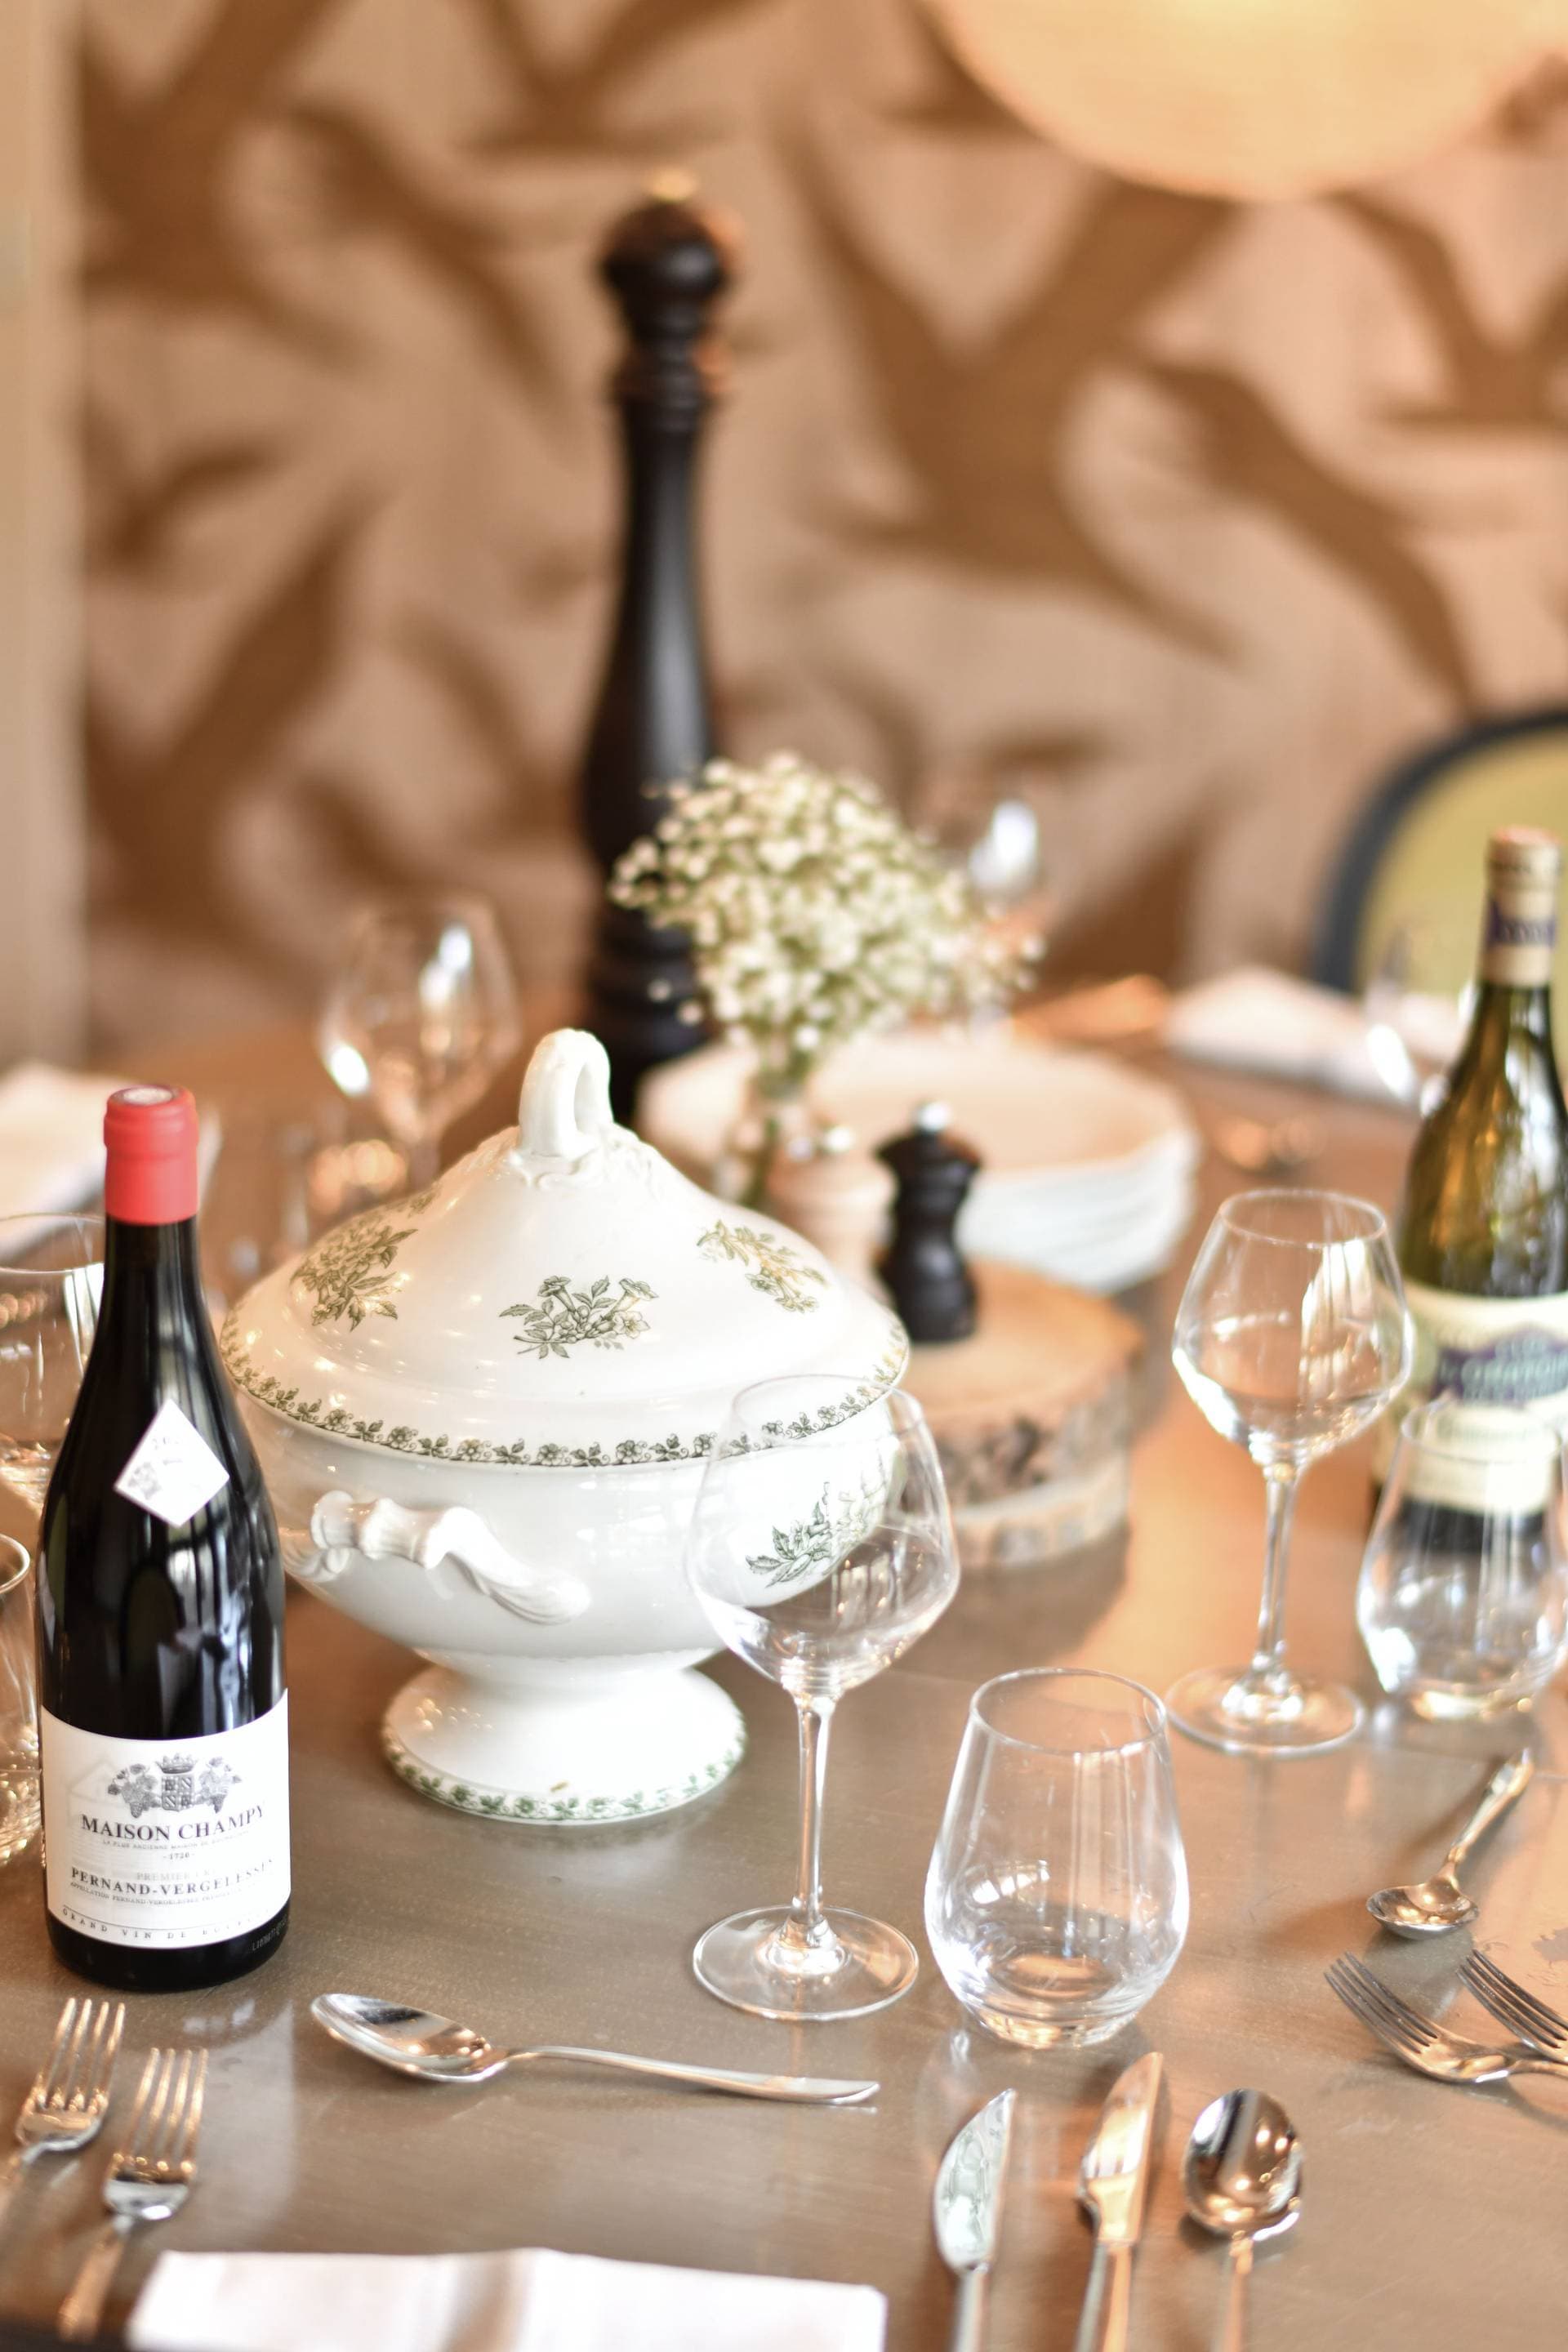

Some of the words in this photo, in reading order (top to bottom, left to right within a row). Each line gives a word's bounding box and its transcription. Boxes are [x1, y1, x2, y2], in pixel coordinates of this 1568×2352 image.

[81, 1813, 170, 1842] MAISON
[177, 1801, 265, 1840] CHAMPY
[62, 1907, 108, 1932] GRAND
[122, 1928, 152, 1939] VIN
